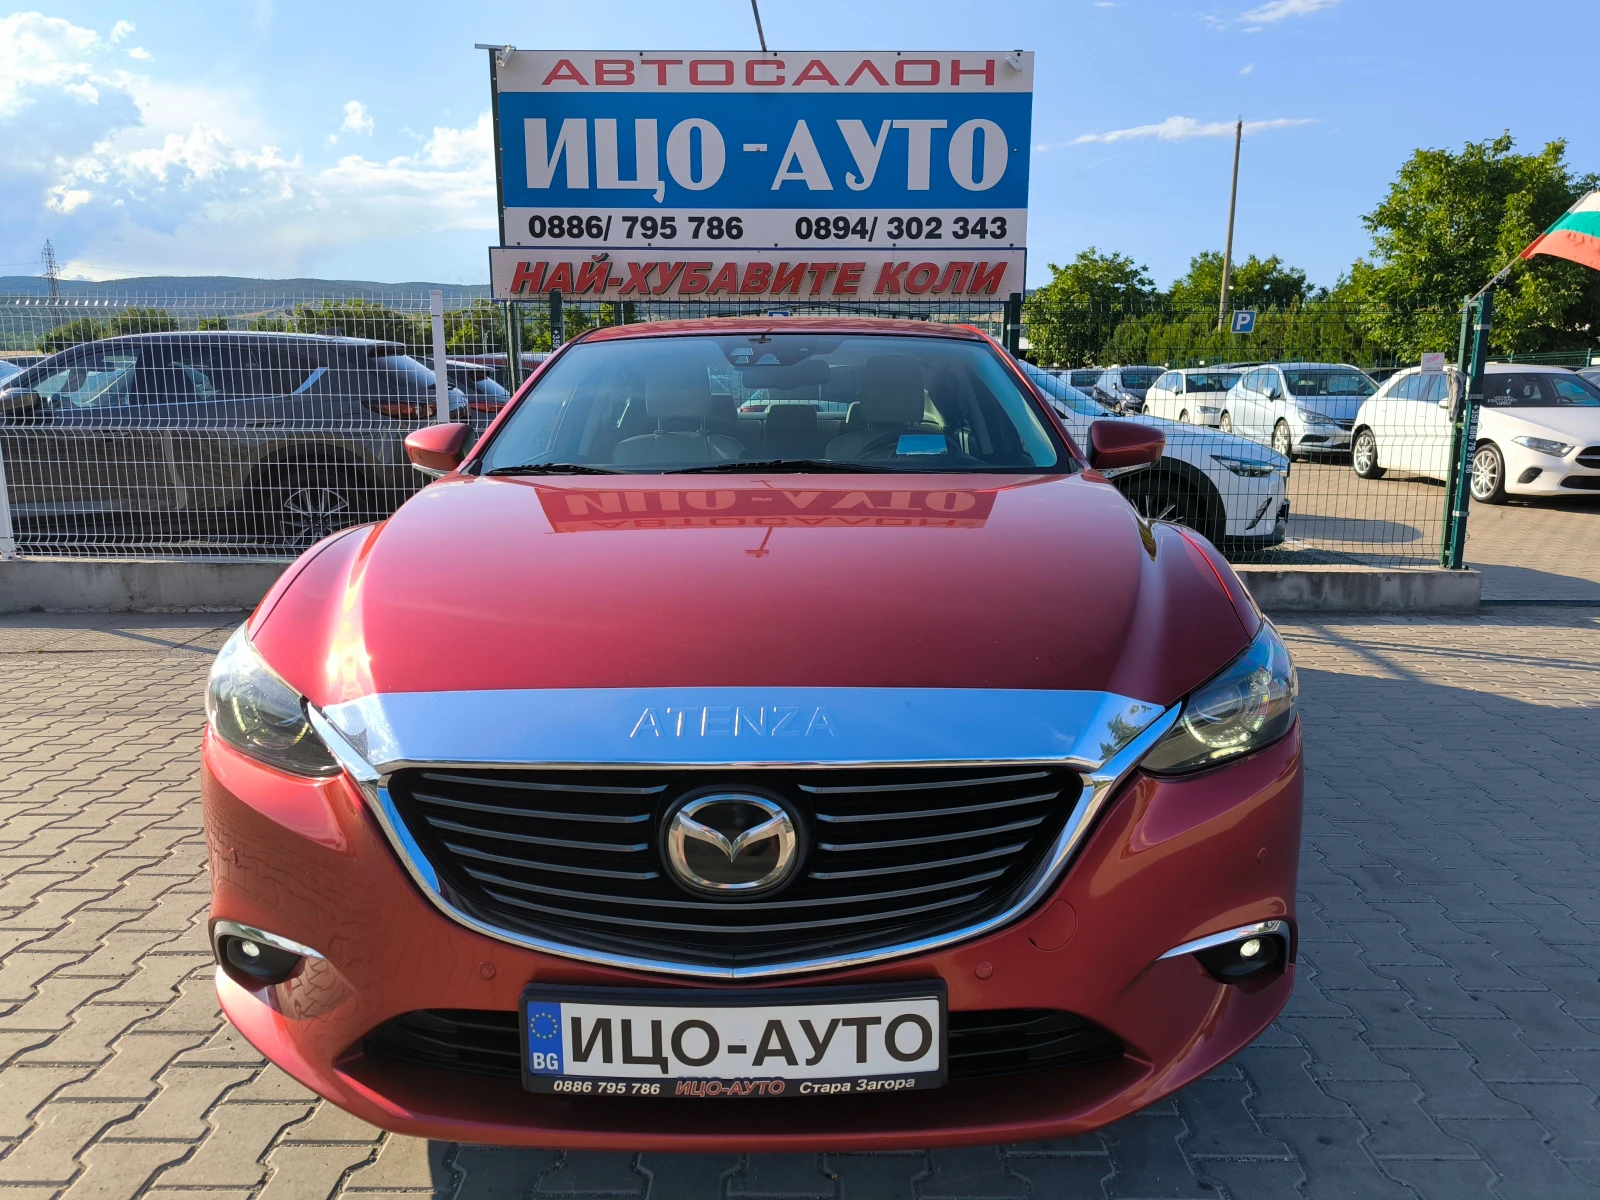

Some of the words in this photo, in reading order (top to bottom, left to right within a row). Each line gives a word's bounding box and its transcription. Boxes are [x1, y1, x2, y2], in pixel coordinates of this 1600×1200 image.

[541, 58, 996, 87] АВТОСАЛОН
[528, 215, 612, 241] 0886/
[621, 216, 678, 240] 795
[688, 216, 744, 240] 786
[795, 216, 878, 242] 0894/
[886, 216, 943, 240] 302
[952, 216, 1007, 240] 343
[509, 252, 867, 295] НАЙ-ХУБАВИТЕ
[873, 261, 1009, 295] КОЛИ
[1235, 313, 1251, 331] P
[1470, 404, 1479, 424] +359
[1469, 425, 1478, 440] 886
[629, 706, 837, 738] ATENZA
[569, 1012, 933, 1075] ИЦО-АУТО
[533, 1052, 559, 1071] BG
[553, 1079, 592, 1093] 0886
[597, 1081, 627, 1094] 795
[631, 1082, 661, 1095] 786
[675, 1079, 786, 1097] ИЦО-АУТО
[799, 1080, 851, 1095] Стара
[855, 1078, 916, 1091] Загора
